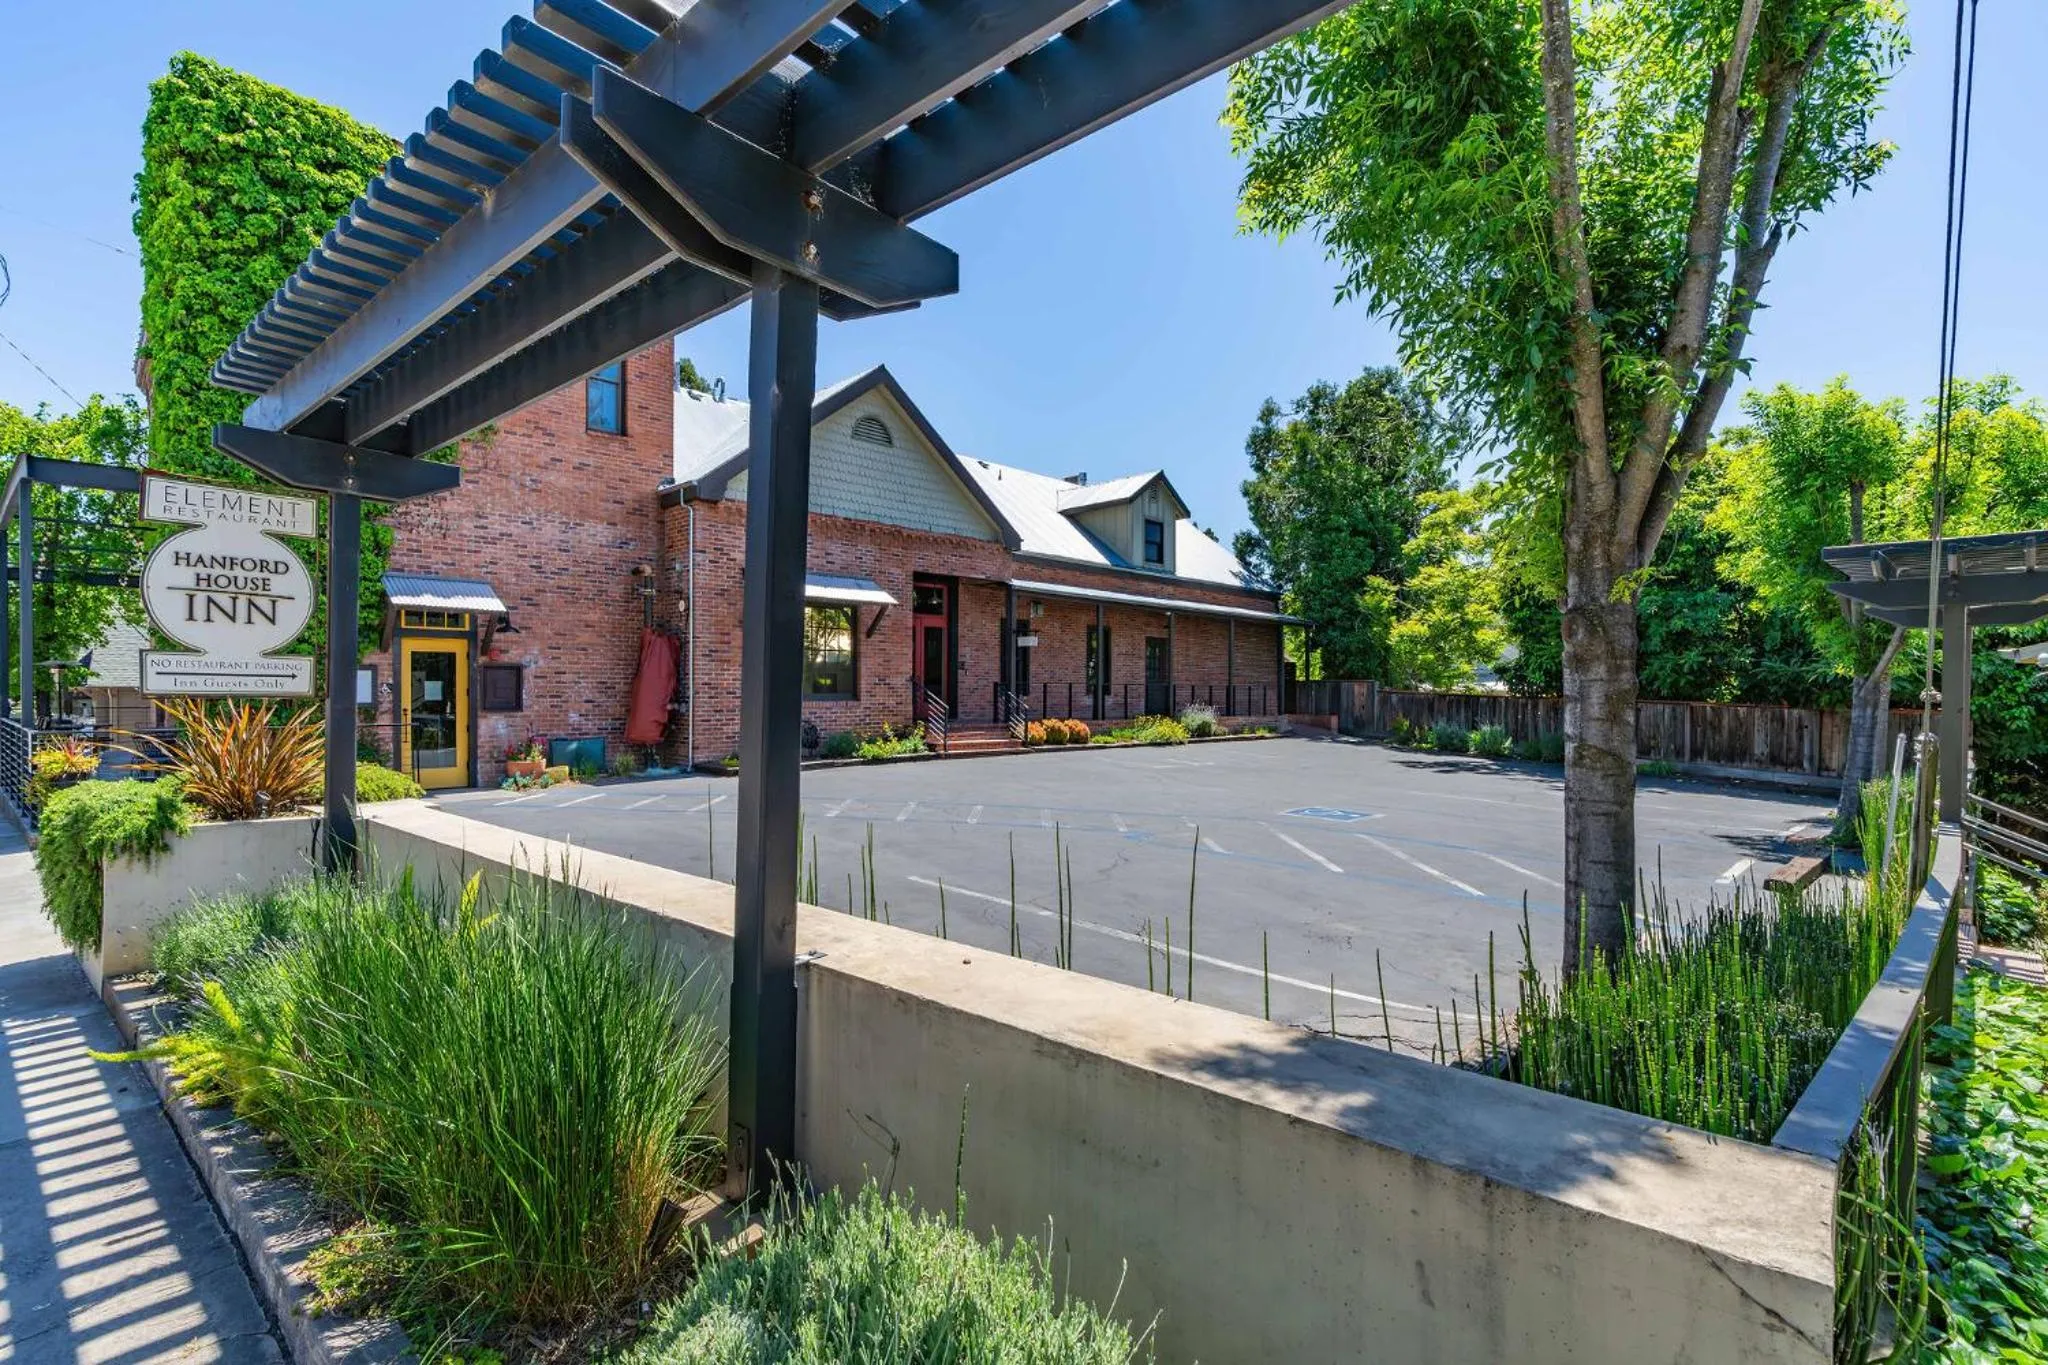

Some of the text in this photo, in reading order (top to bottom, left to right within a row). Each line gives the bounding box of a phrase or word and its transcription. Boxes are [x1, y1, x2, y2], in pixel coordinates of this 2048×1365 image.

[163, 484, 303, 518] ELEMENT
[163, 504, 301, 529] RESTAURANT
[173, 551, 290, 576] HANFORD
[194, 572, 272, 592] HOUSE
[184, 593, 279, 626] INN
[150, 659, 303, 672] NO RESTAURANT PARKING
[173, 677, 286, 690] Inn Guests Only
